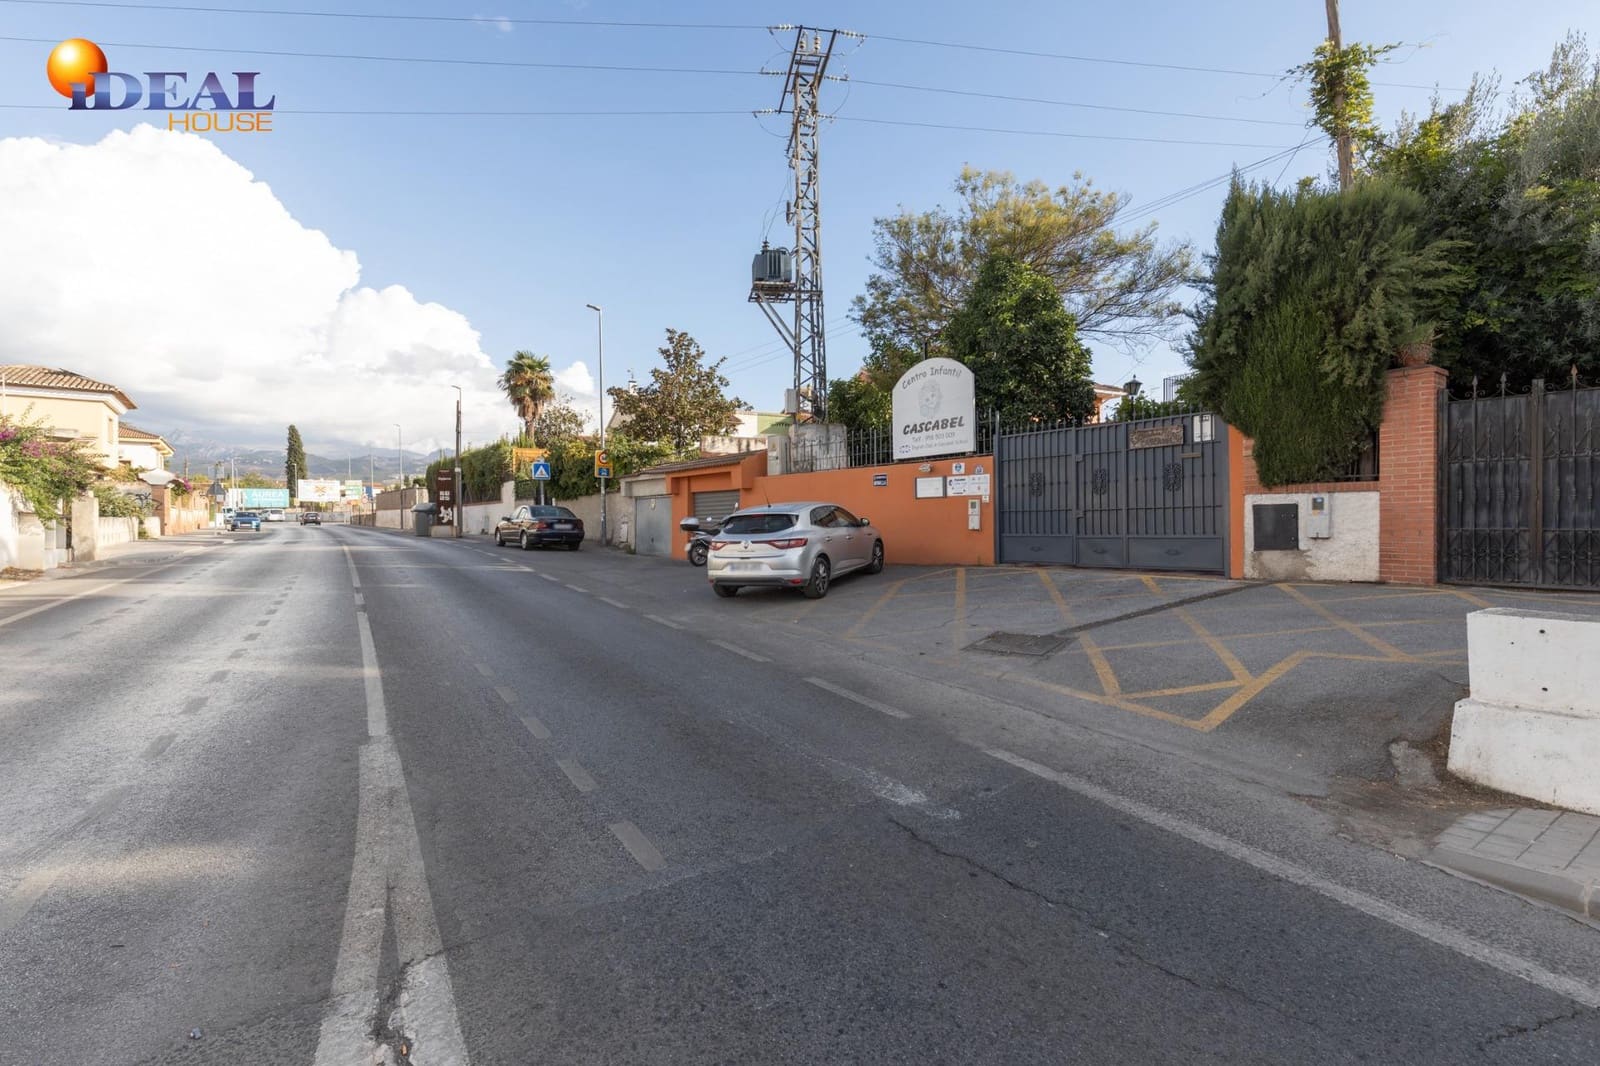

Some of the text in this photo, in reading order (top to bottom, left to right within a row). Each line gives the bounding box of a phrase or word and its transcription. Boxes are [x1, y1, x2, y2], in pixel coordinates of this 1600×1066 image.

[902, 365, 962, 389] Centro Infantil
[903, 416, 965, 435] CASCABEL
